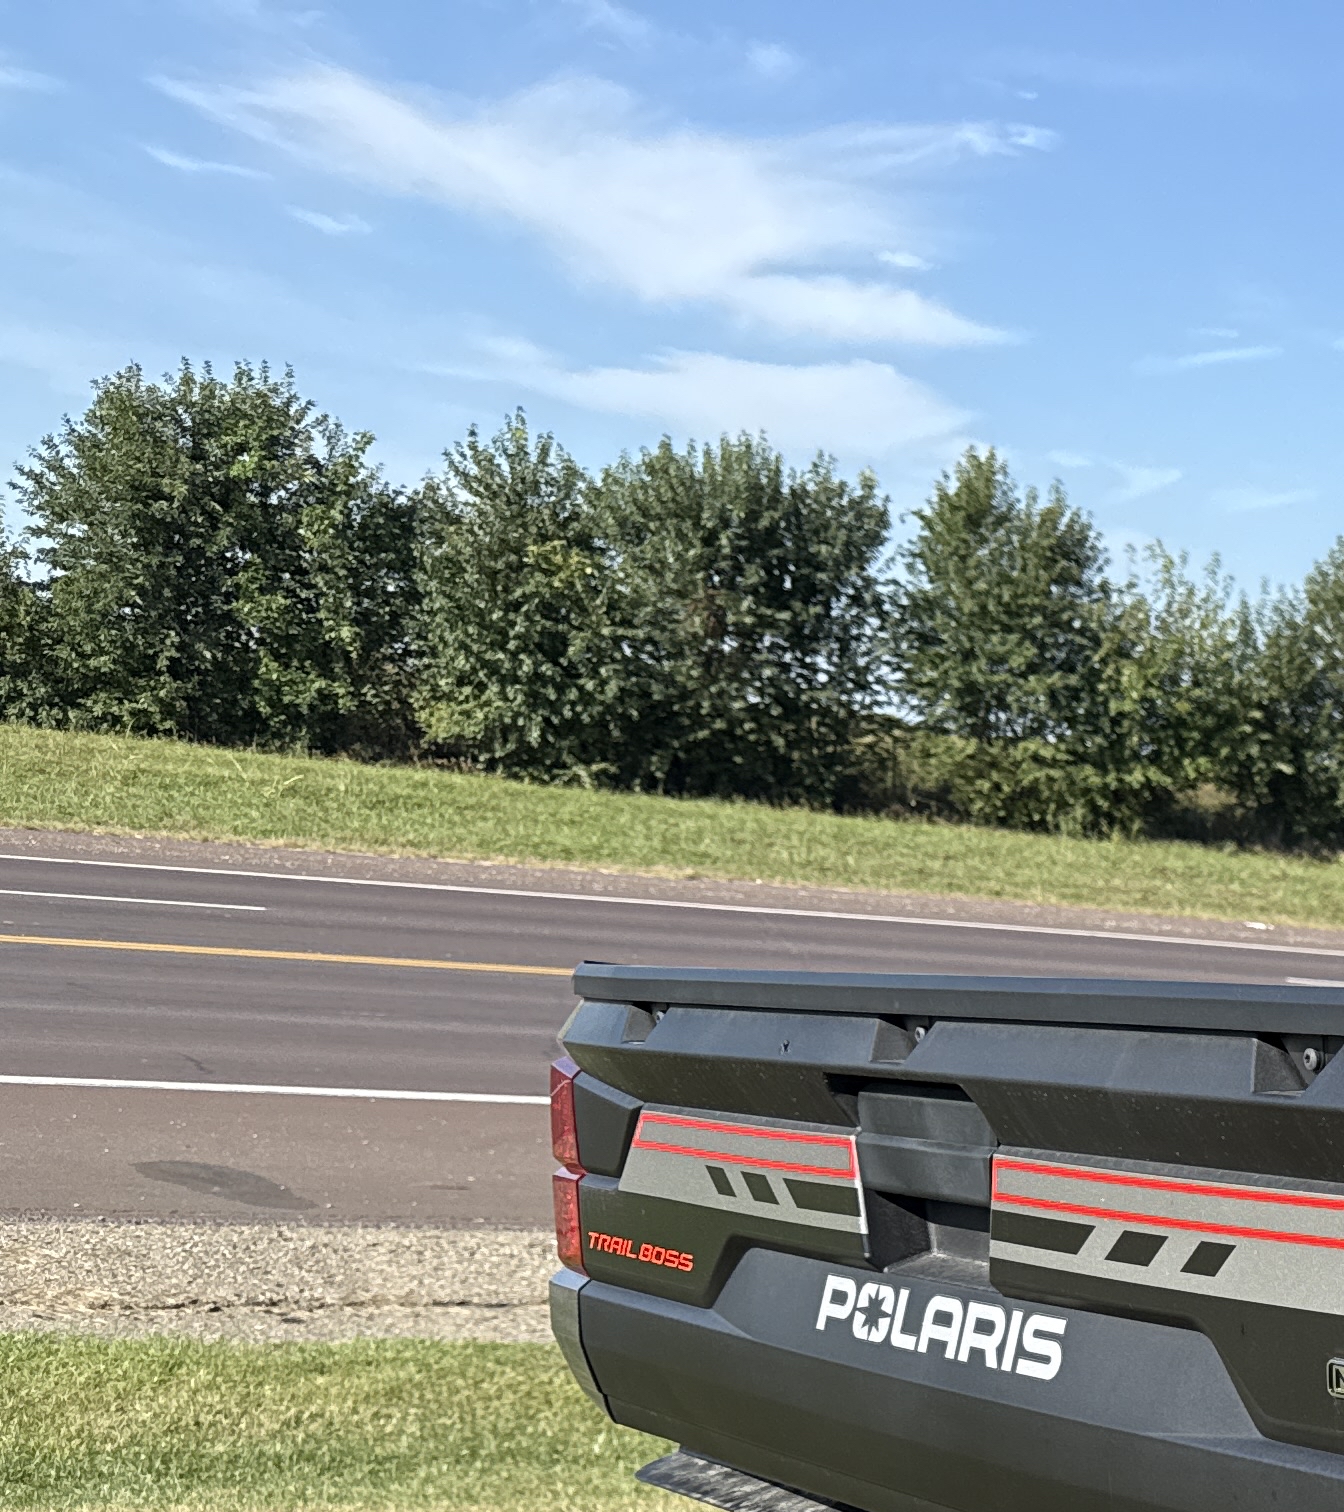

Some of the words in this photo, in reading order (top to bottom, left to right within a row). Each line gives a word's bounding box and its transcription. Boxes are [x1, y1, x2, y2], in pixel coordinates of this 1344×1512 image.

[588, 1231, 637, 1259] TRAIL
[638, 1242, 694, 1272] BOSS
[815, 1273, 1068, 1381] POLARIS
